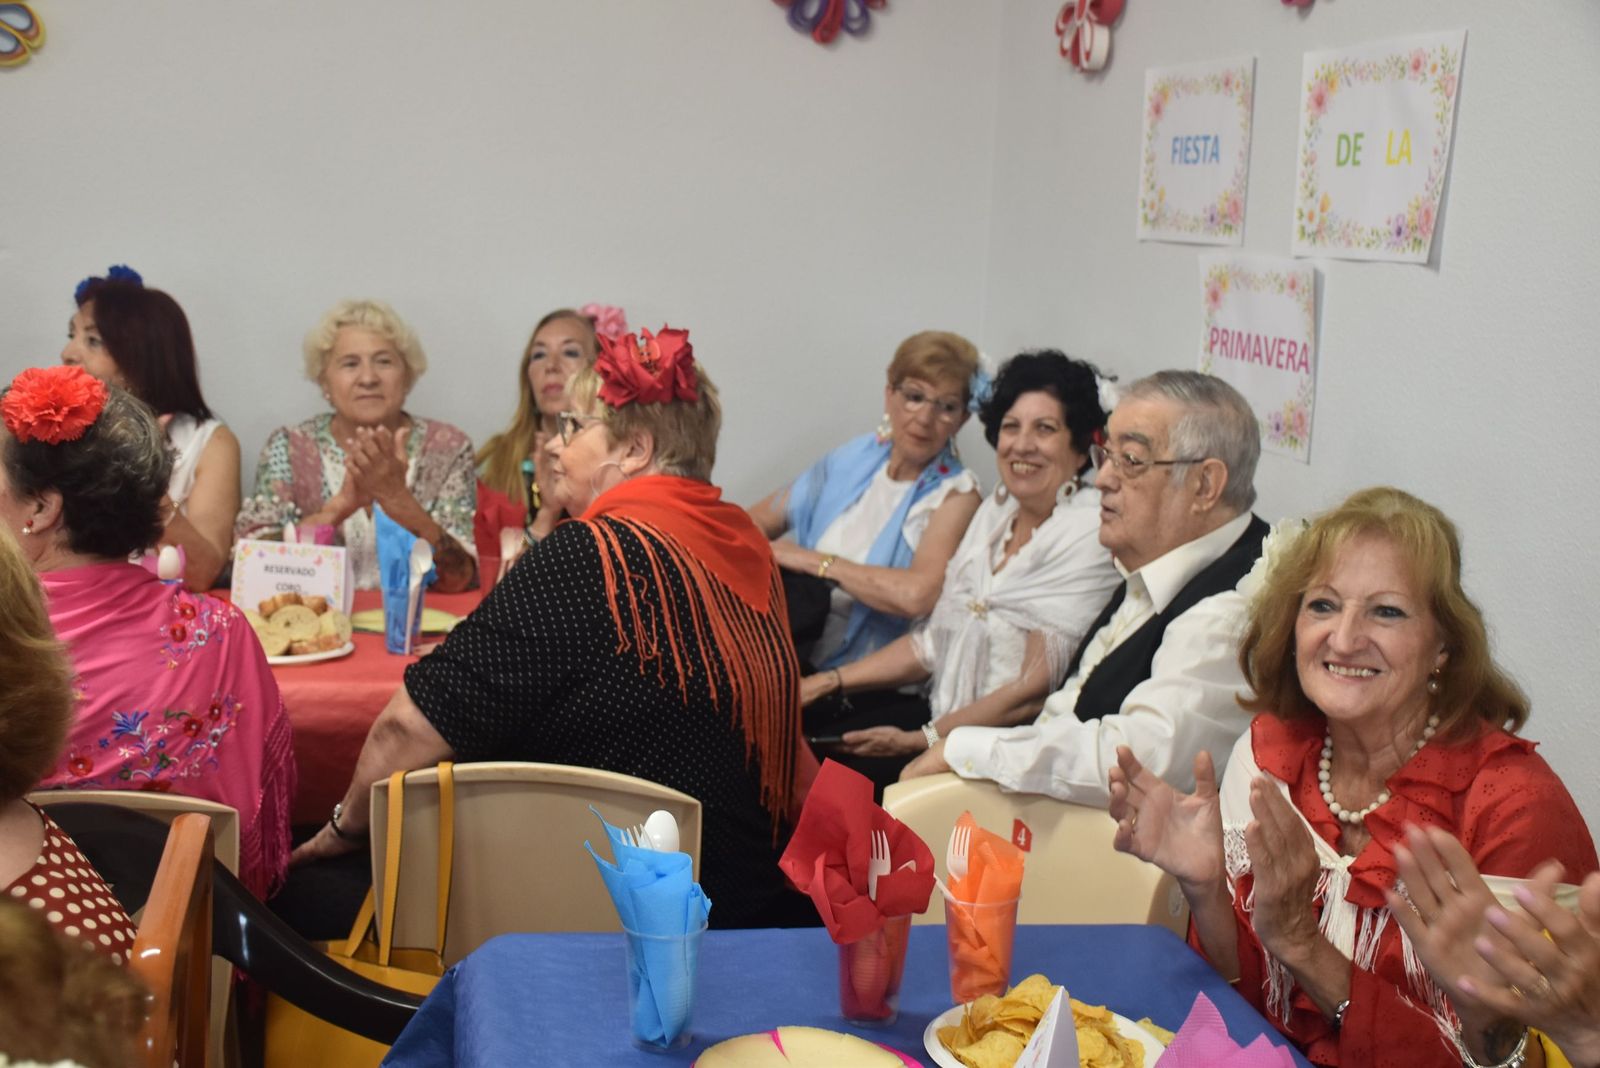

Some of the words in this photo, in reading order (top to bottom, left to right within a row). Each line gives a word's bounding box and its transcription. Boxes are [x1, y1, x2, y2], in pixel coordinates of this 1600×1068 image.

[1172, 135, 1220, 165] FIESTA
[1336, 132, 1364, 166] DE
[1385, 129, 1412, 165] LA
[1209, 327, 1310, 374] PRIMAVERA
[264, 565, 316, 577] RESERVADO
[1017, 827, 1026, 846] 4
